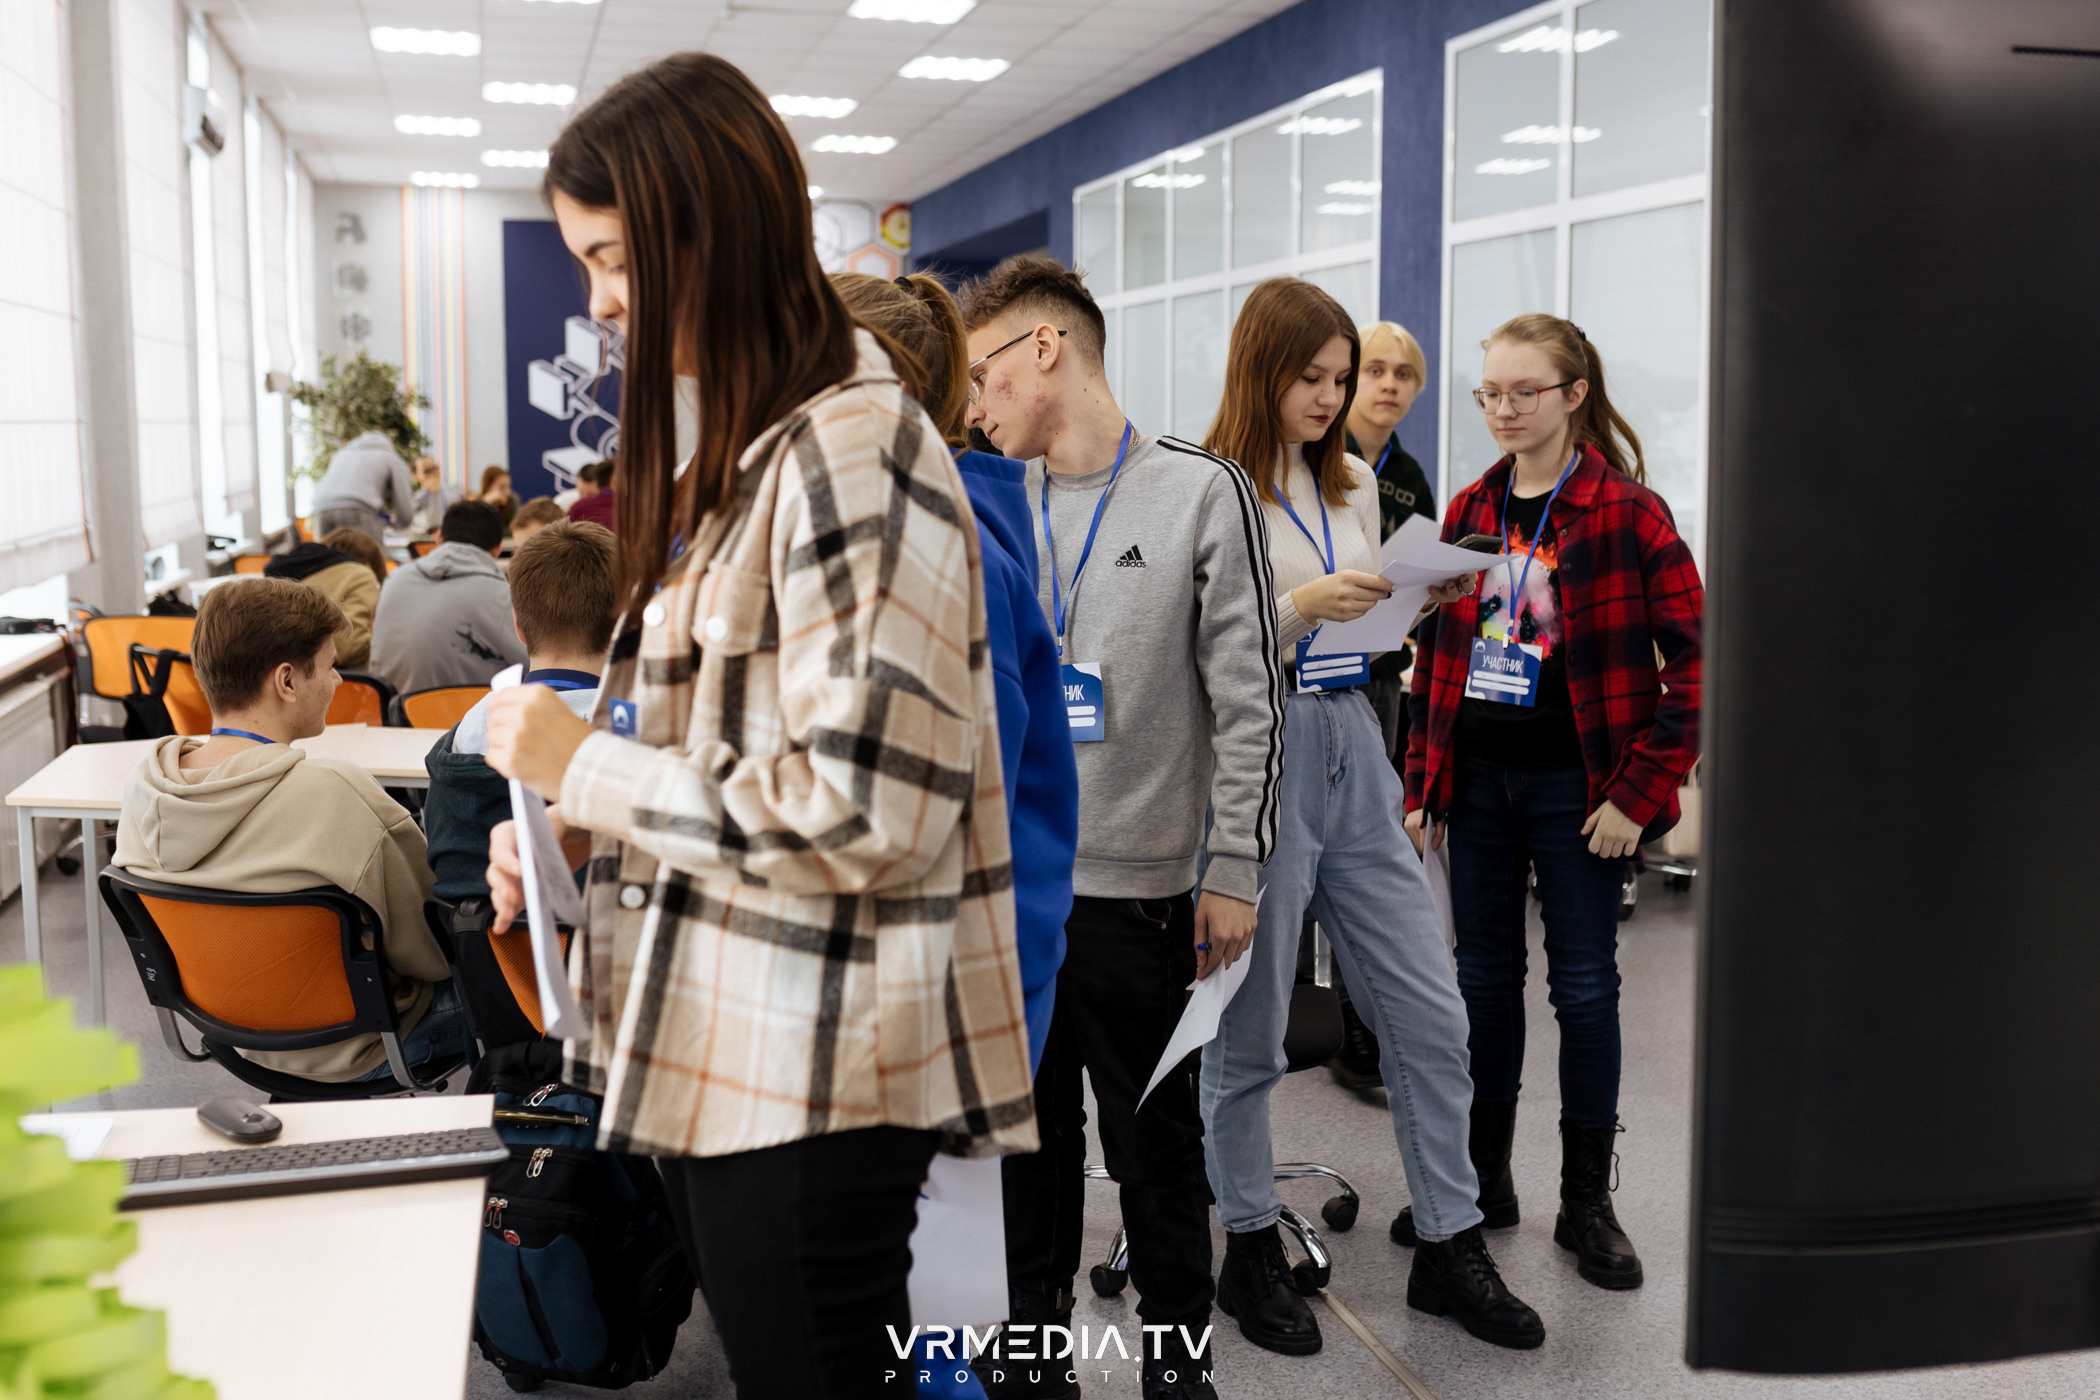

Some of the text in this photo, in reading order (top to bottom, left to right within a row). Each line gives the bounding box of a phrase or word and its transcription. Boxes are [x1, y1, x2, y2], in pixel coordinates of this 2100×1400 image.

[1116, 559, 1147, 568] adidas
[1482, 655, 1524, 674] УЧАСТНИК
[1062, 684, 1085, 701] НИК
